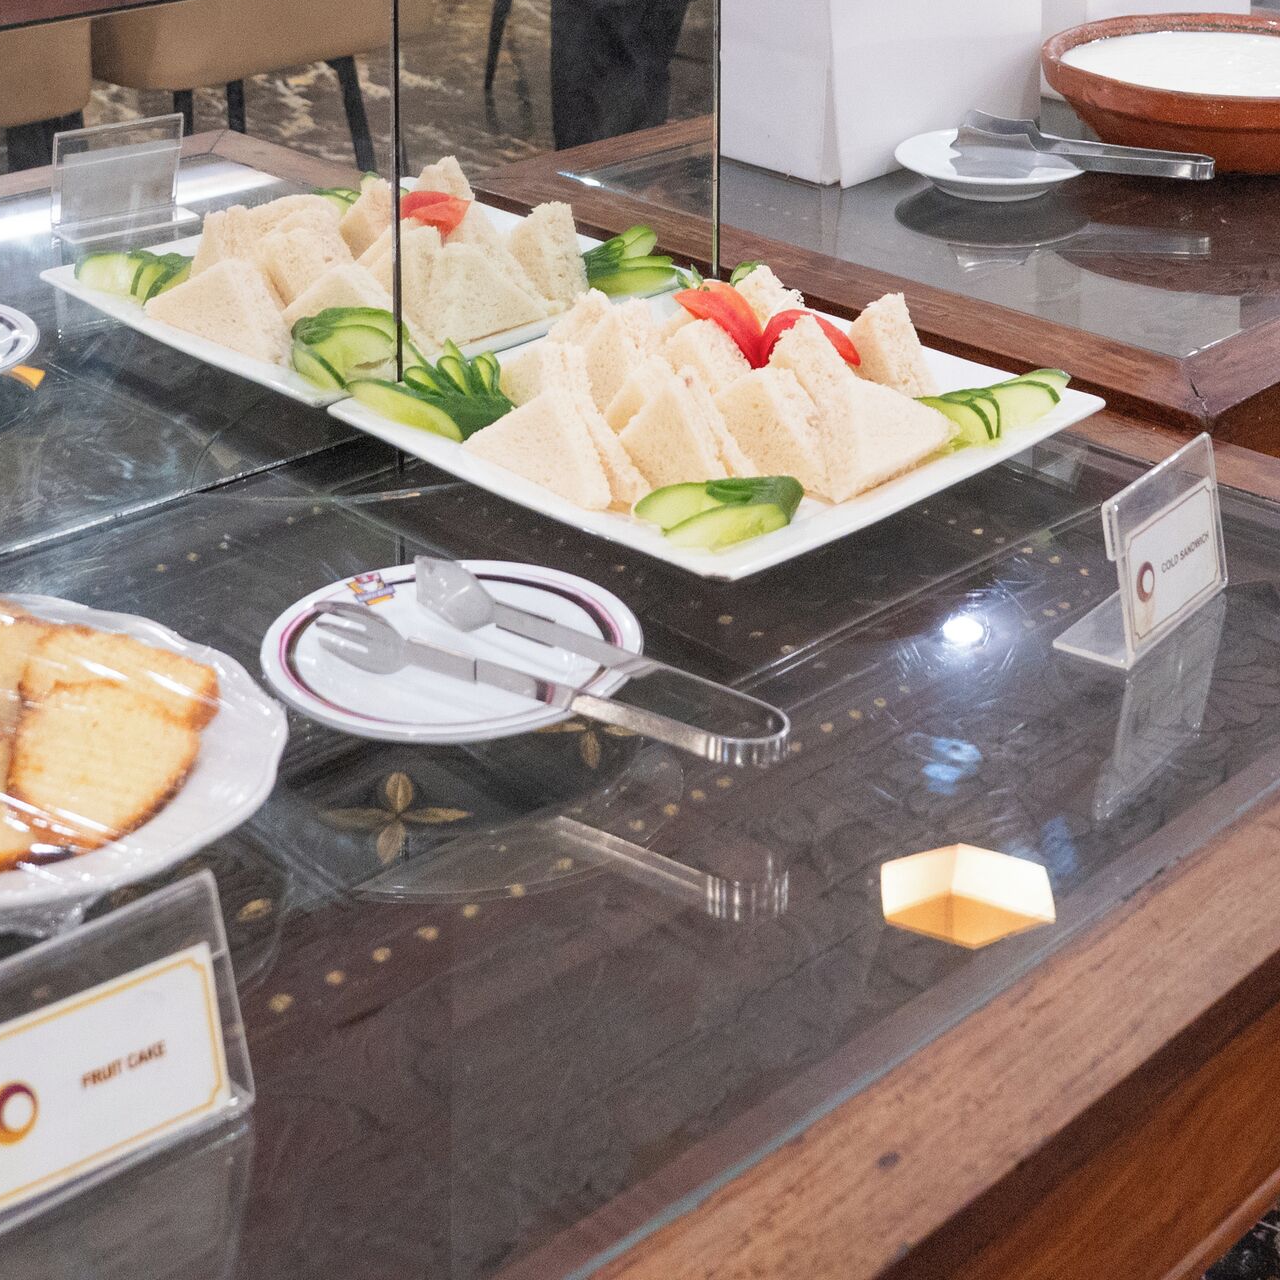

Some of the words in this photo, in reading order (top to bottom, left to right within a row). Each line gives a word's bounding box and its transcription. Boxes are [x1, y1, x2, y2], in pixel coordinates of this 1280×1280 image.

[1161, 554, 1179, 573] COLD
[1180, 530, 1209, 560] SANDWICH
[82, 1058, 122, 1088] FRUIT
[127, 1039, 166, 1070] CAKE
